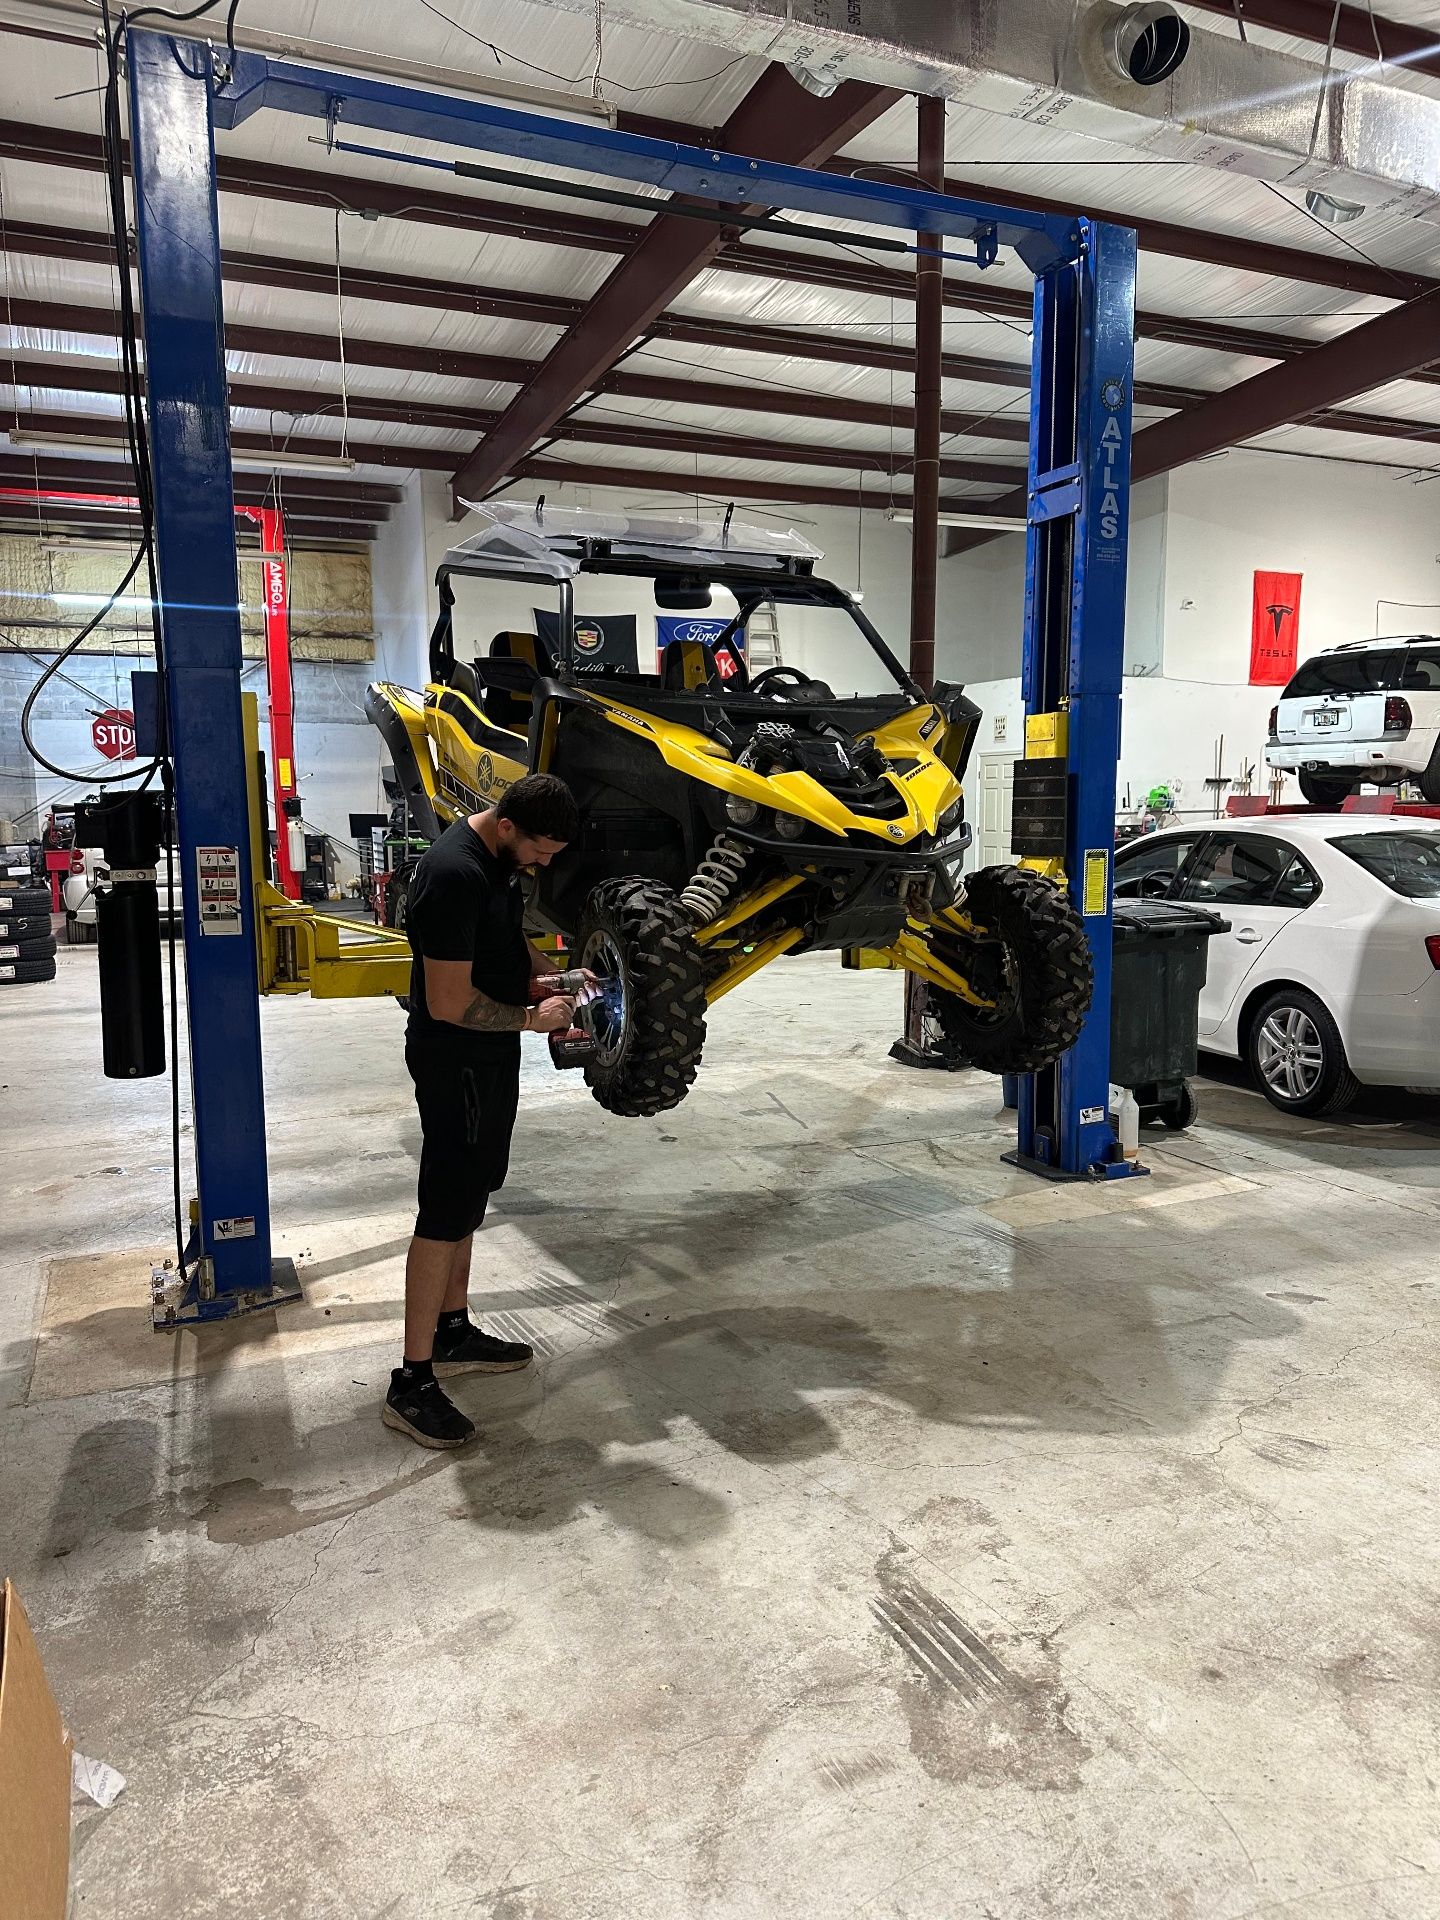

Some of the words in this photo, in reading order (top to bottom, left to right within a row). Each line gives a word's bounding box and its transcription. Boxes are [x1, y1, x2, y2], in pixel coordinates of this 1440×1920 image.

[1100, 416, 1122, 539] ATLAS
[269, 561, 284, 604] AMGO
[686, 623, 723, 642] Ford
[1260, 648, 1293, 658] TESLA
[611, 706, 644, 726] YAMAHA
